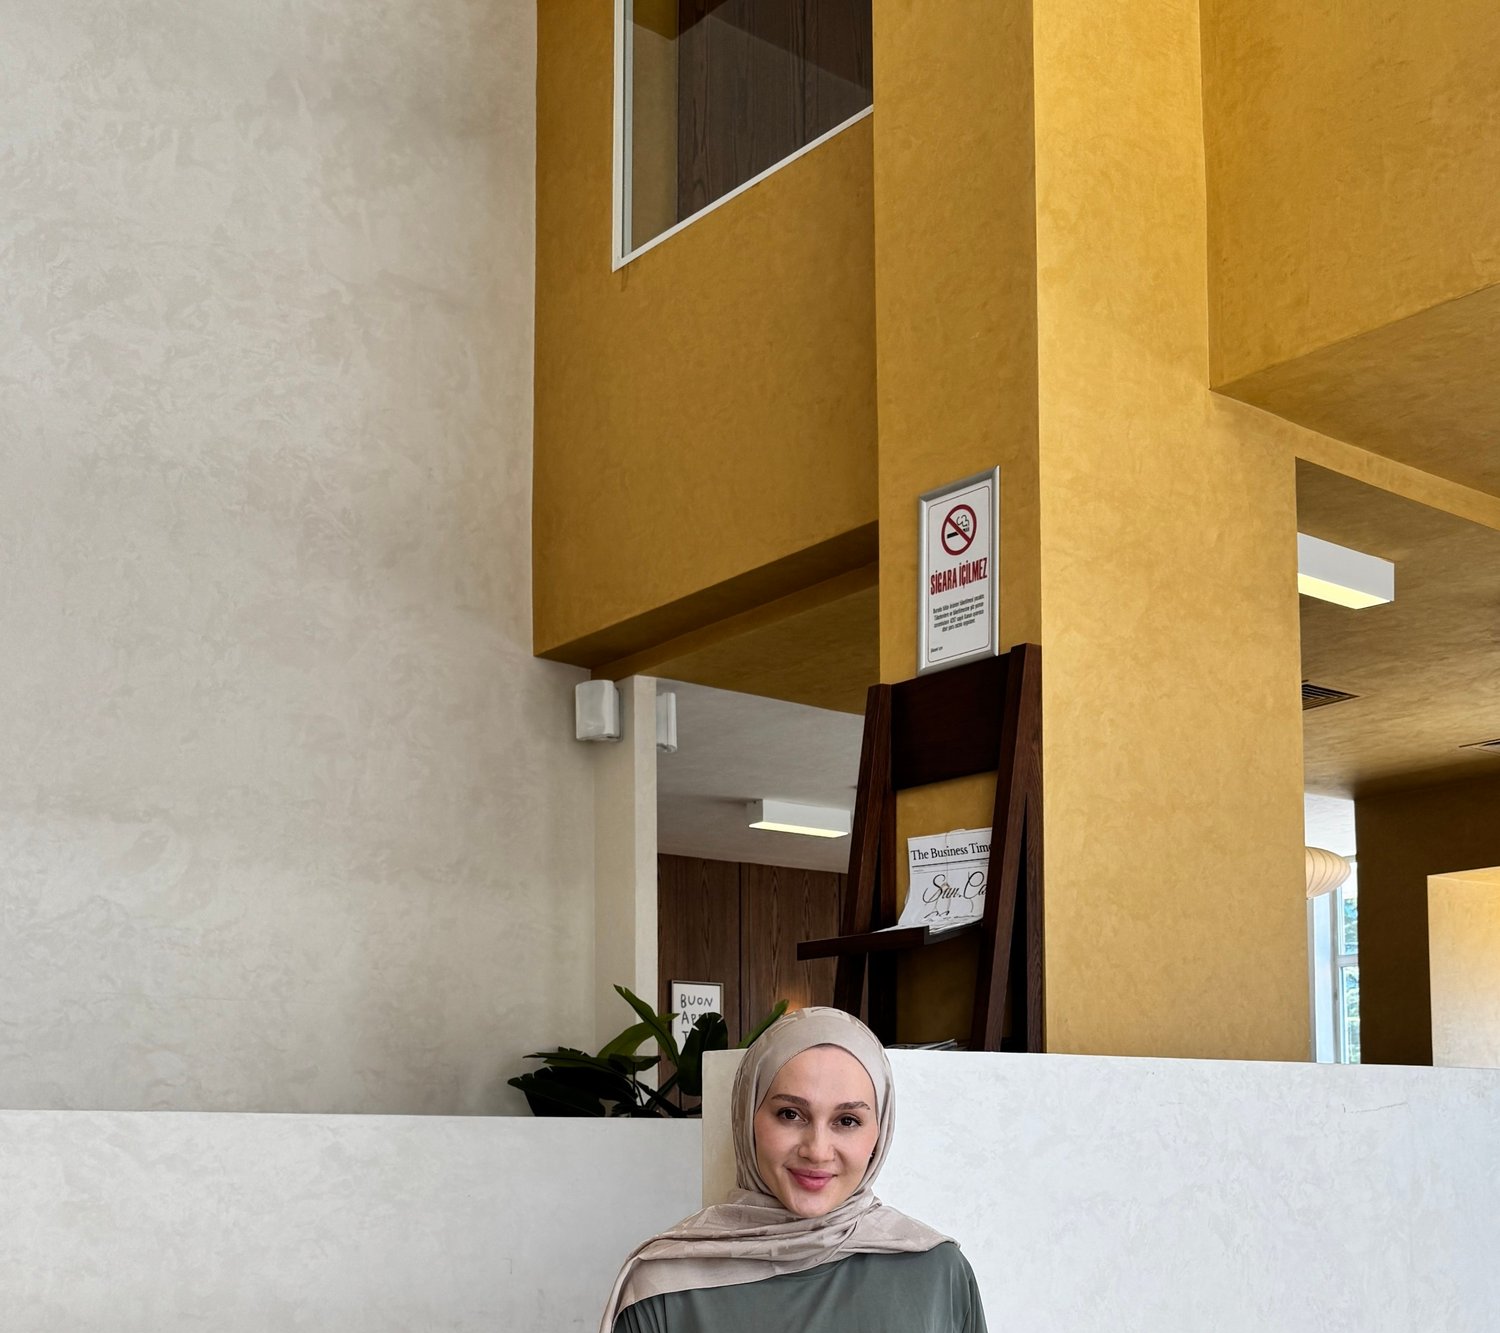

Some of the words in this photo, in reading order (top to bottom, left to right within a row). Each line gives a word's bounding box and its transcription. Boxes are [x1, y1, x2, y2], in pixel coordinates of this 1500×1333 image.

[930, 568, 957, 595] SİGARA
[959, 557, 987, 588] İÇİLMEZ
[910, 849, 929, 860] The
[930, 845, 969, 859] Business
[680, 993, 713, 1009] BUON
